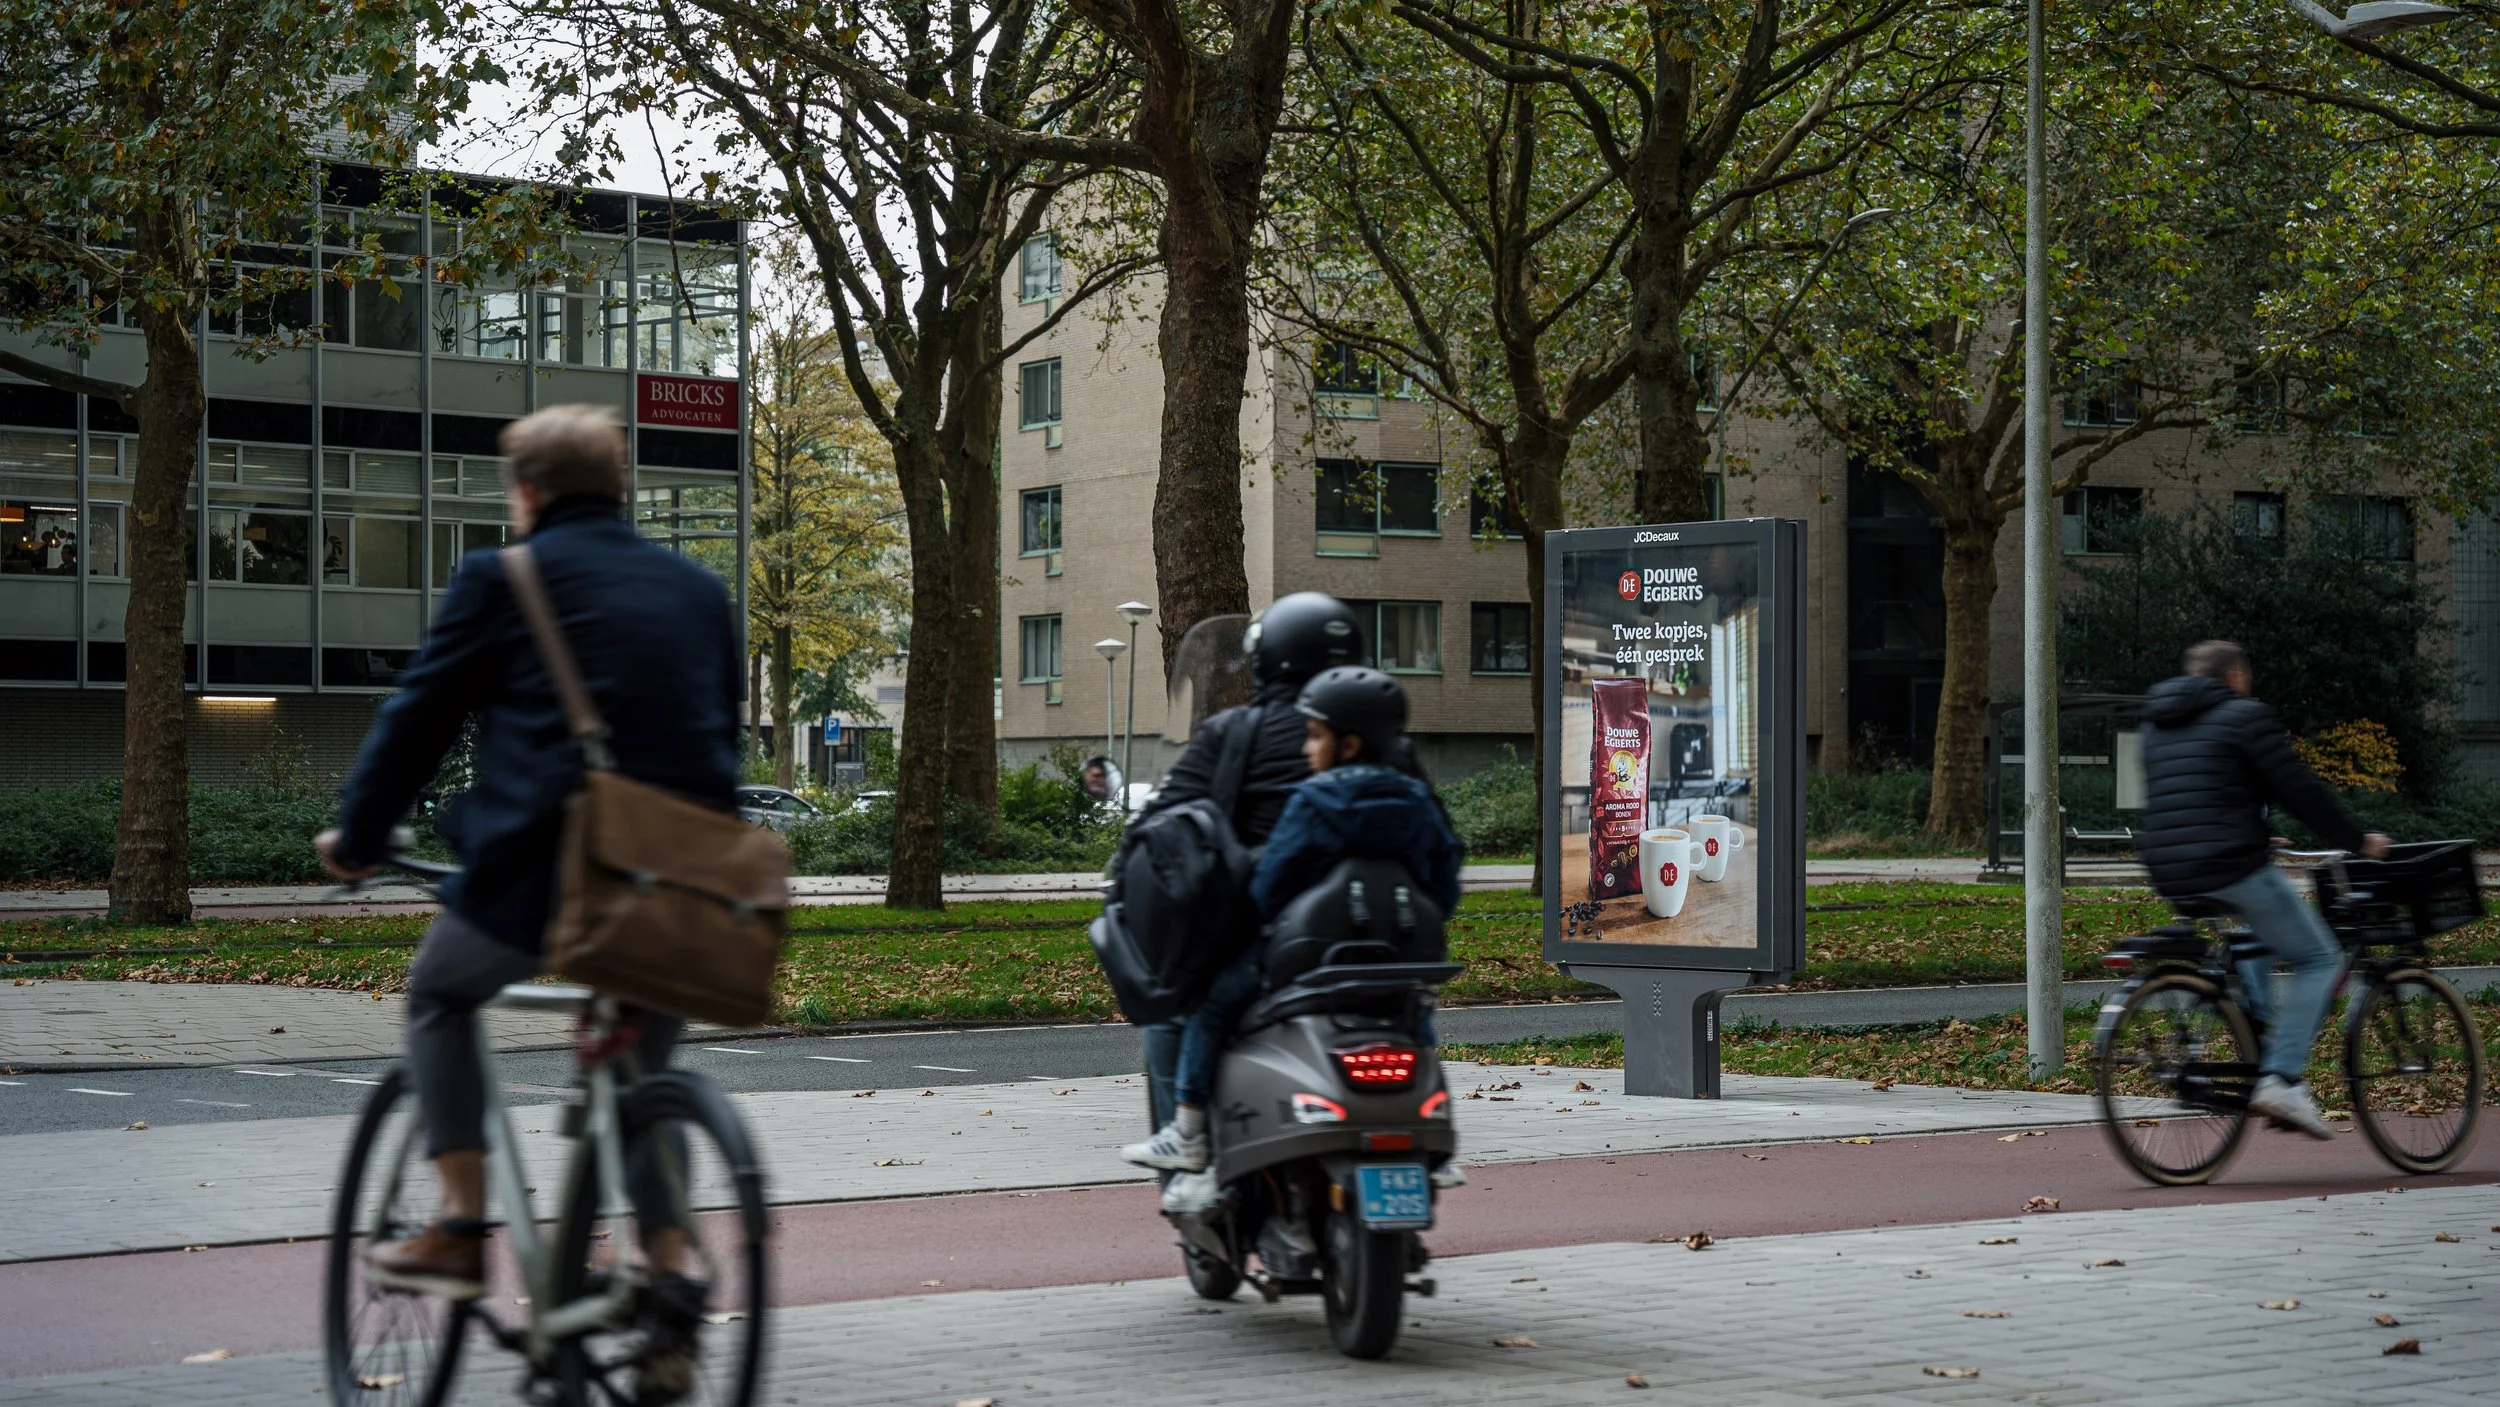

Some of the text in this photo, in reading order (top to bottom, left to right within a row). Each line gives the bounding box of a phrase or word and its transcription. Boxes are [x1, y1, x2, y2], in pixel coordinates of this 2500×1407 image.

[650, 381, 724, 406] BRICKS
[651, 408, 722, 422] ADVOCATEN
[1633, 531, 1680, 543] JCDecaux
[1643, 584, 1704, 603] EGBERTS
[1612, 621, 1708, 644] Twee kopjes,
[1615, 644, 1705, 667] één gesprek
[828, 719, 837, 731] P
[1604, 736, 1641, 748] EGBERTS
[1626, 802, 1640, 810] ROOD
